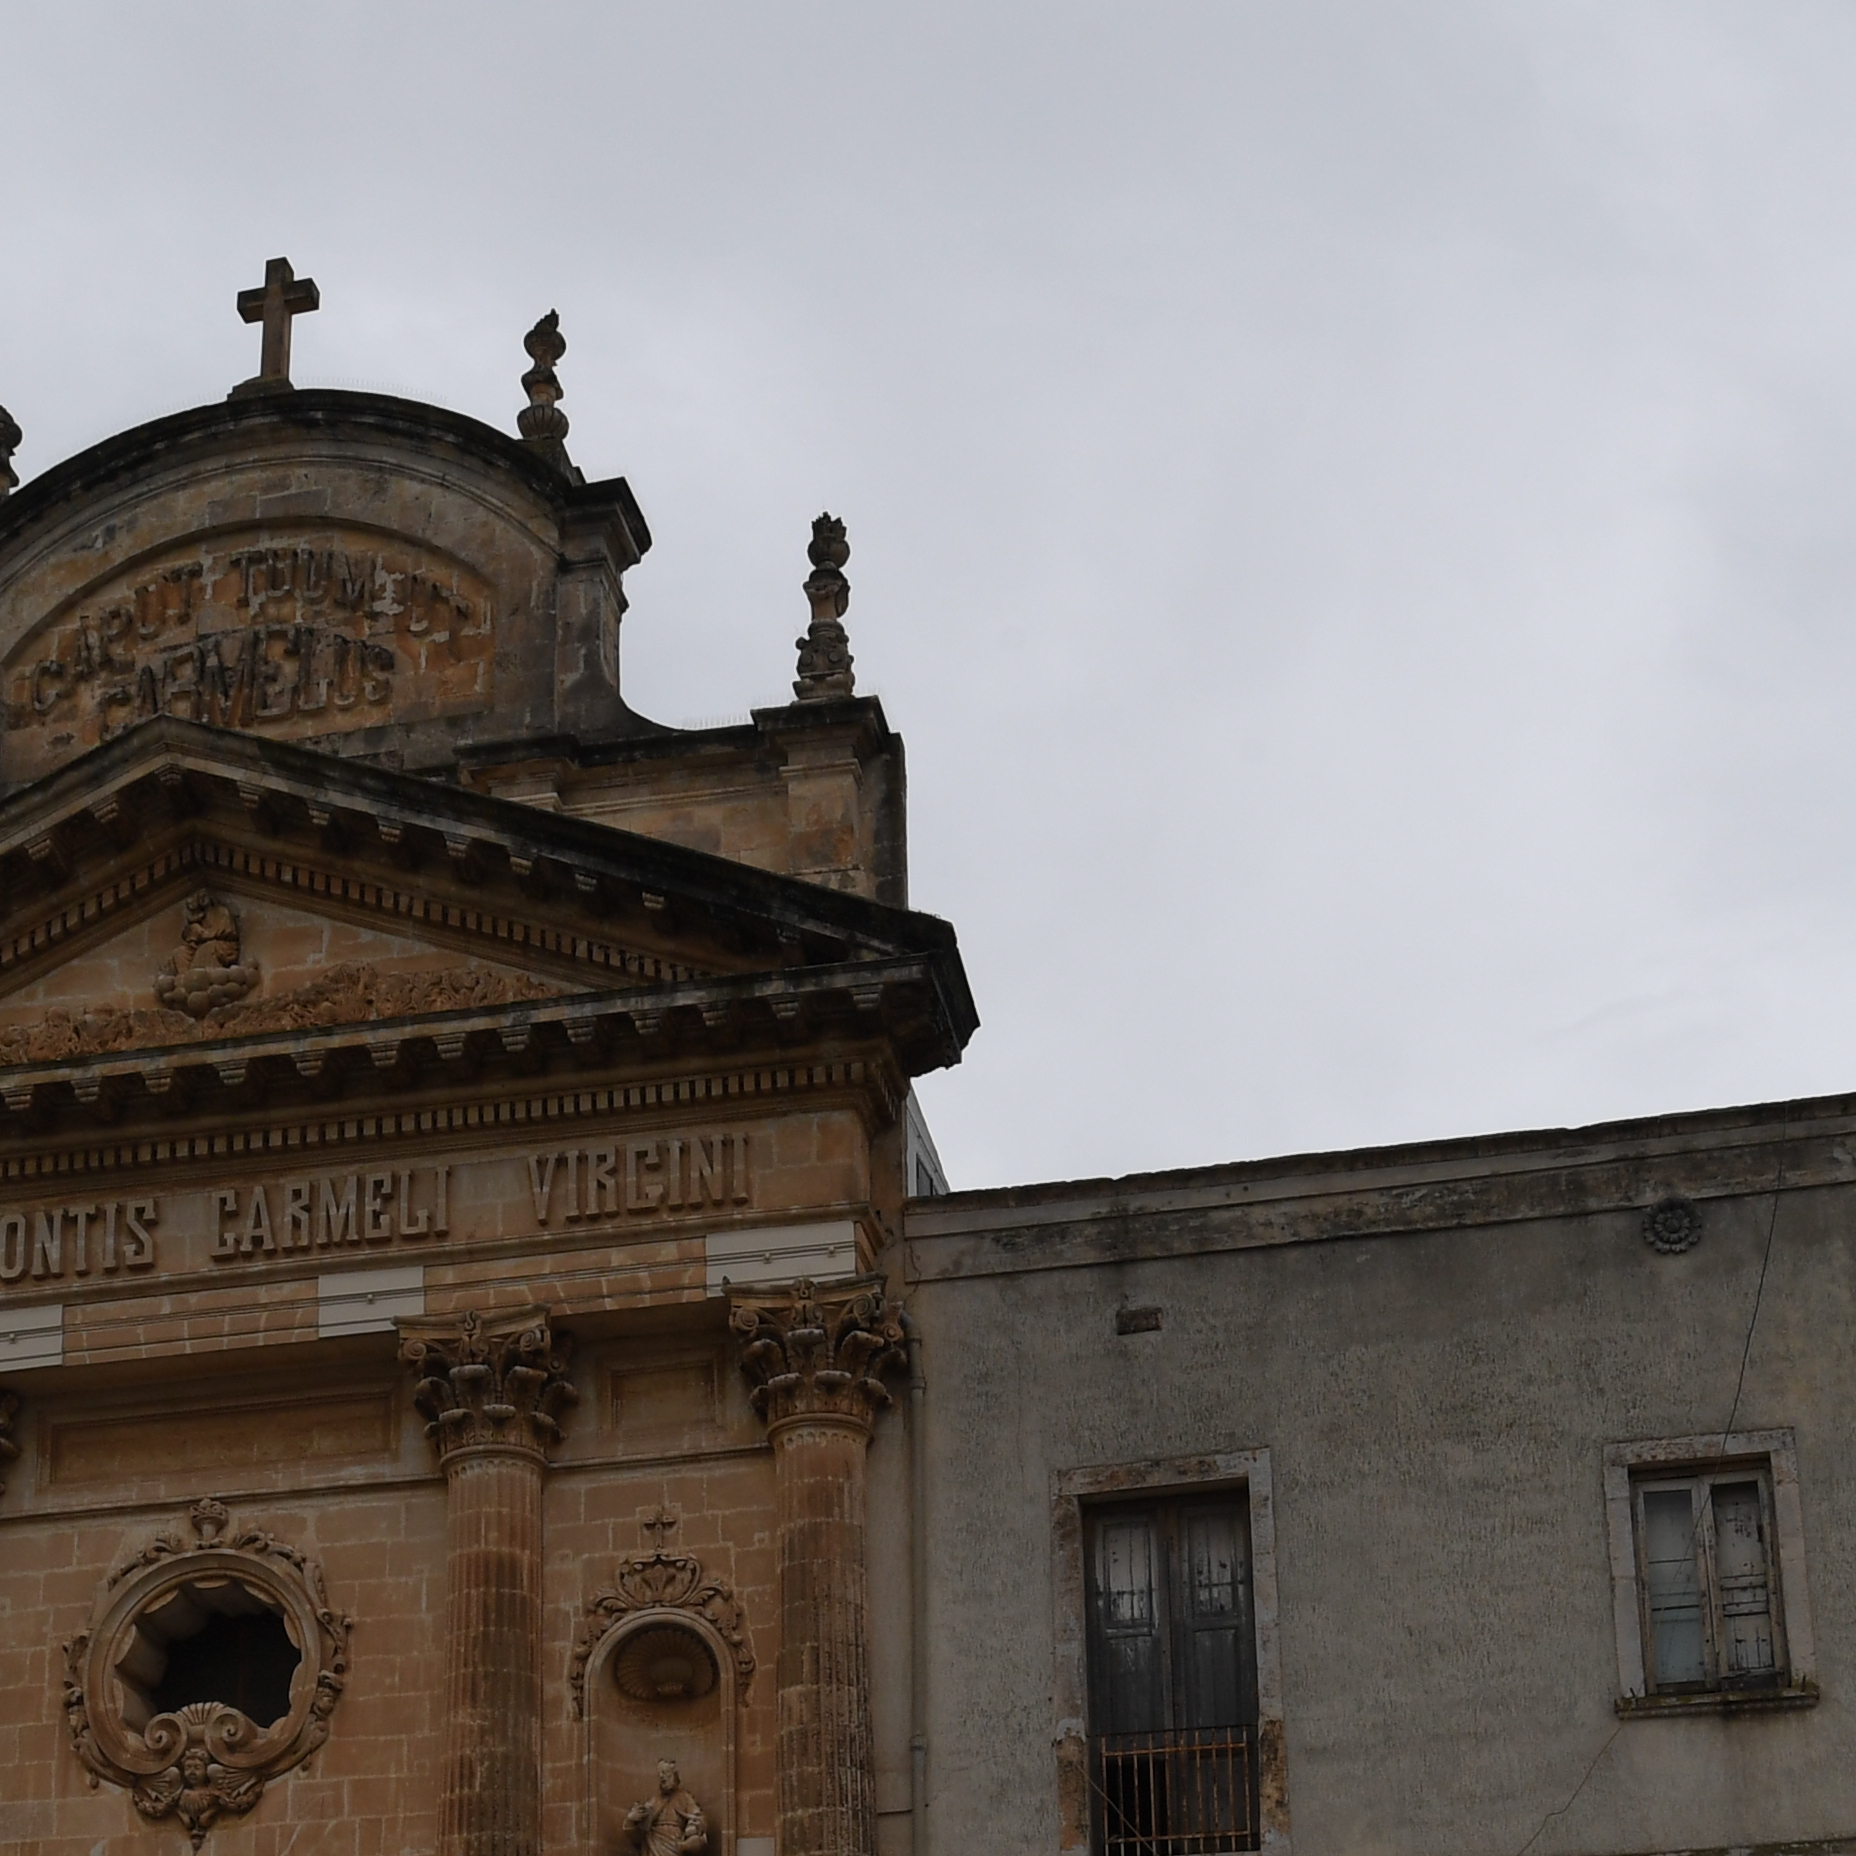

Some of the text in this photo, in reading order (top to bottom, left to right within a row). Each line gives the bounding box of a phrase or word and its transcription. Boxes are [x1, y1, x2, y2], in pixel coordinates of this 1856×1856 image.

[30, 562, 204, 712] CAPUT
[210, 1165, 453, 1261] CARMELI
[527, 1132, 751, 1226] VIRGINI
